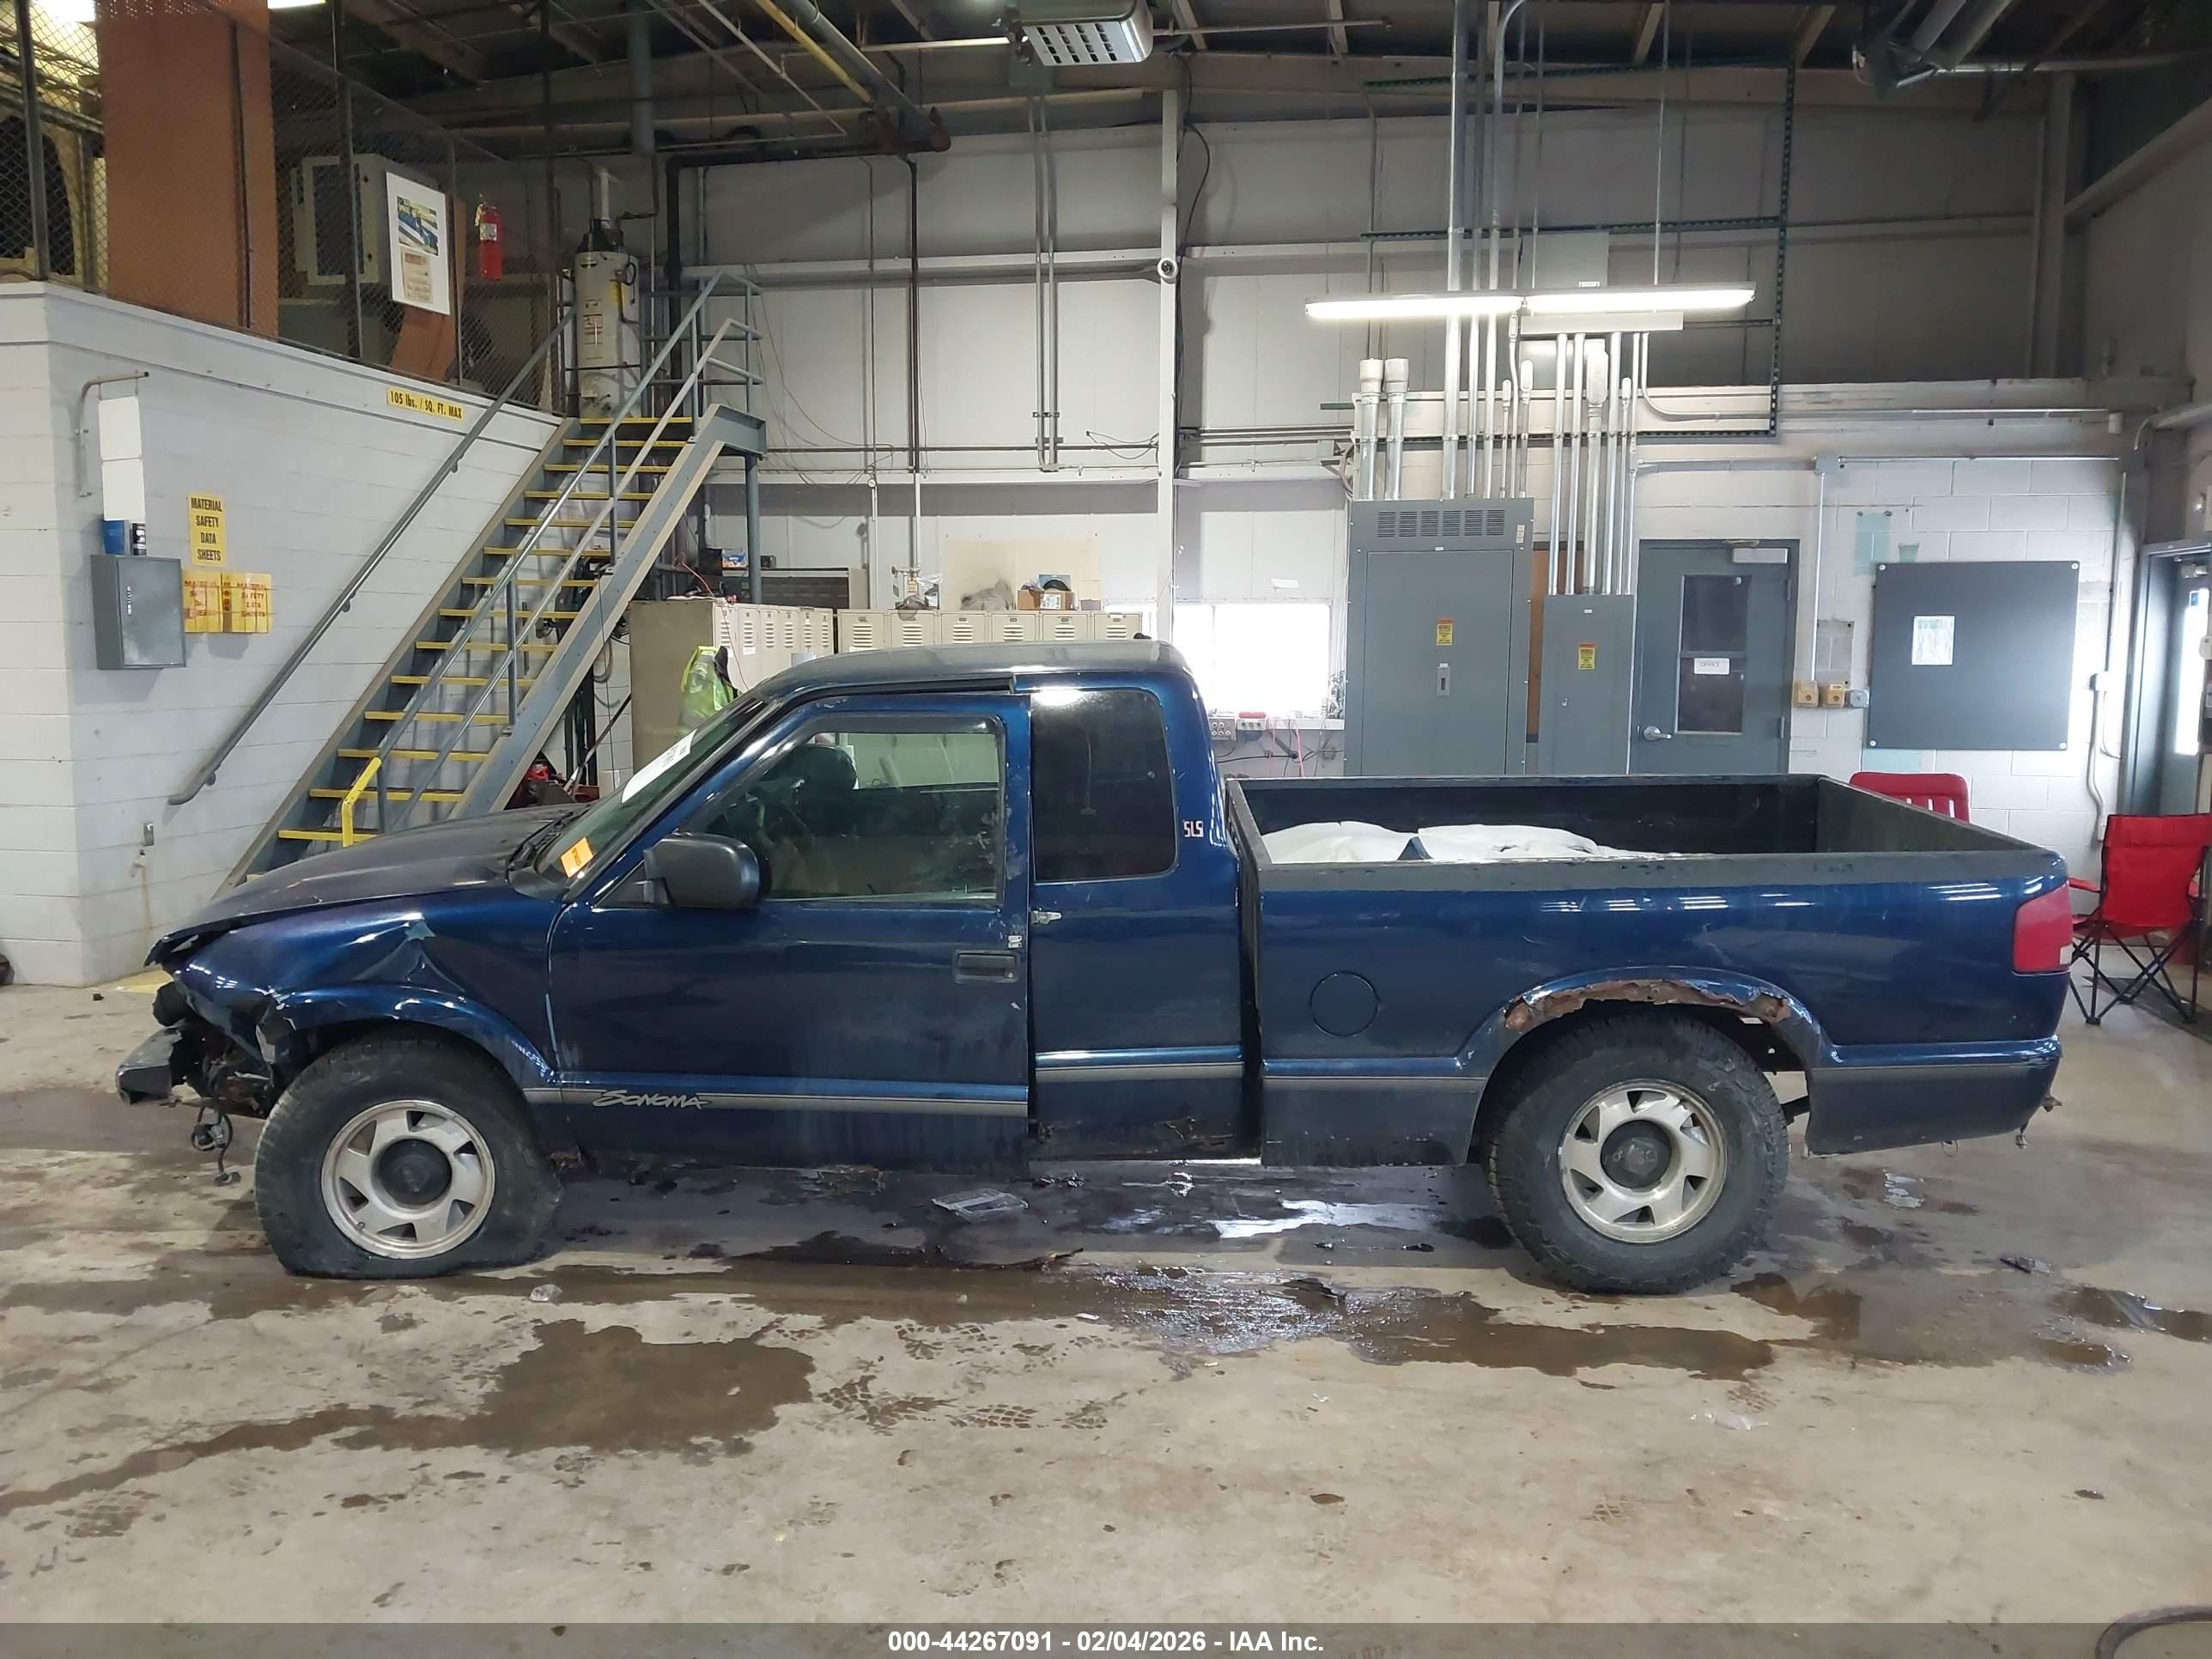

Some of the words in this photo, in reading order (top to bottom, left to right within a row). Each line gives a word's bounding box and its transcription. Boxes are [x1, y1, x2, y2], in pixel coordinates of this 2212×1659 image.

[391, 391, 403, 404] 105
[405, 393, 417, 408] lbs.
[425, 399, 434, 412] SQ.
[437, 402, 447, 415] FT.
[448, 404, 462, 419] MAX
[191, 497, 222, 512] MATERIAL
[196, 515, 219, 527] SAFETY
[200, 532, 217, 544] DATA
[198, 549, 222, 561] SHEETS
[1184, 820, 1204, 837] SLS
